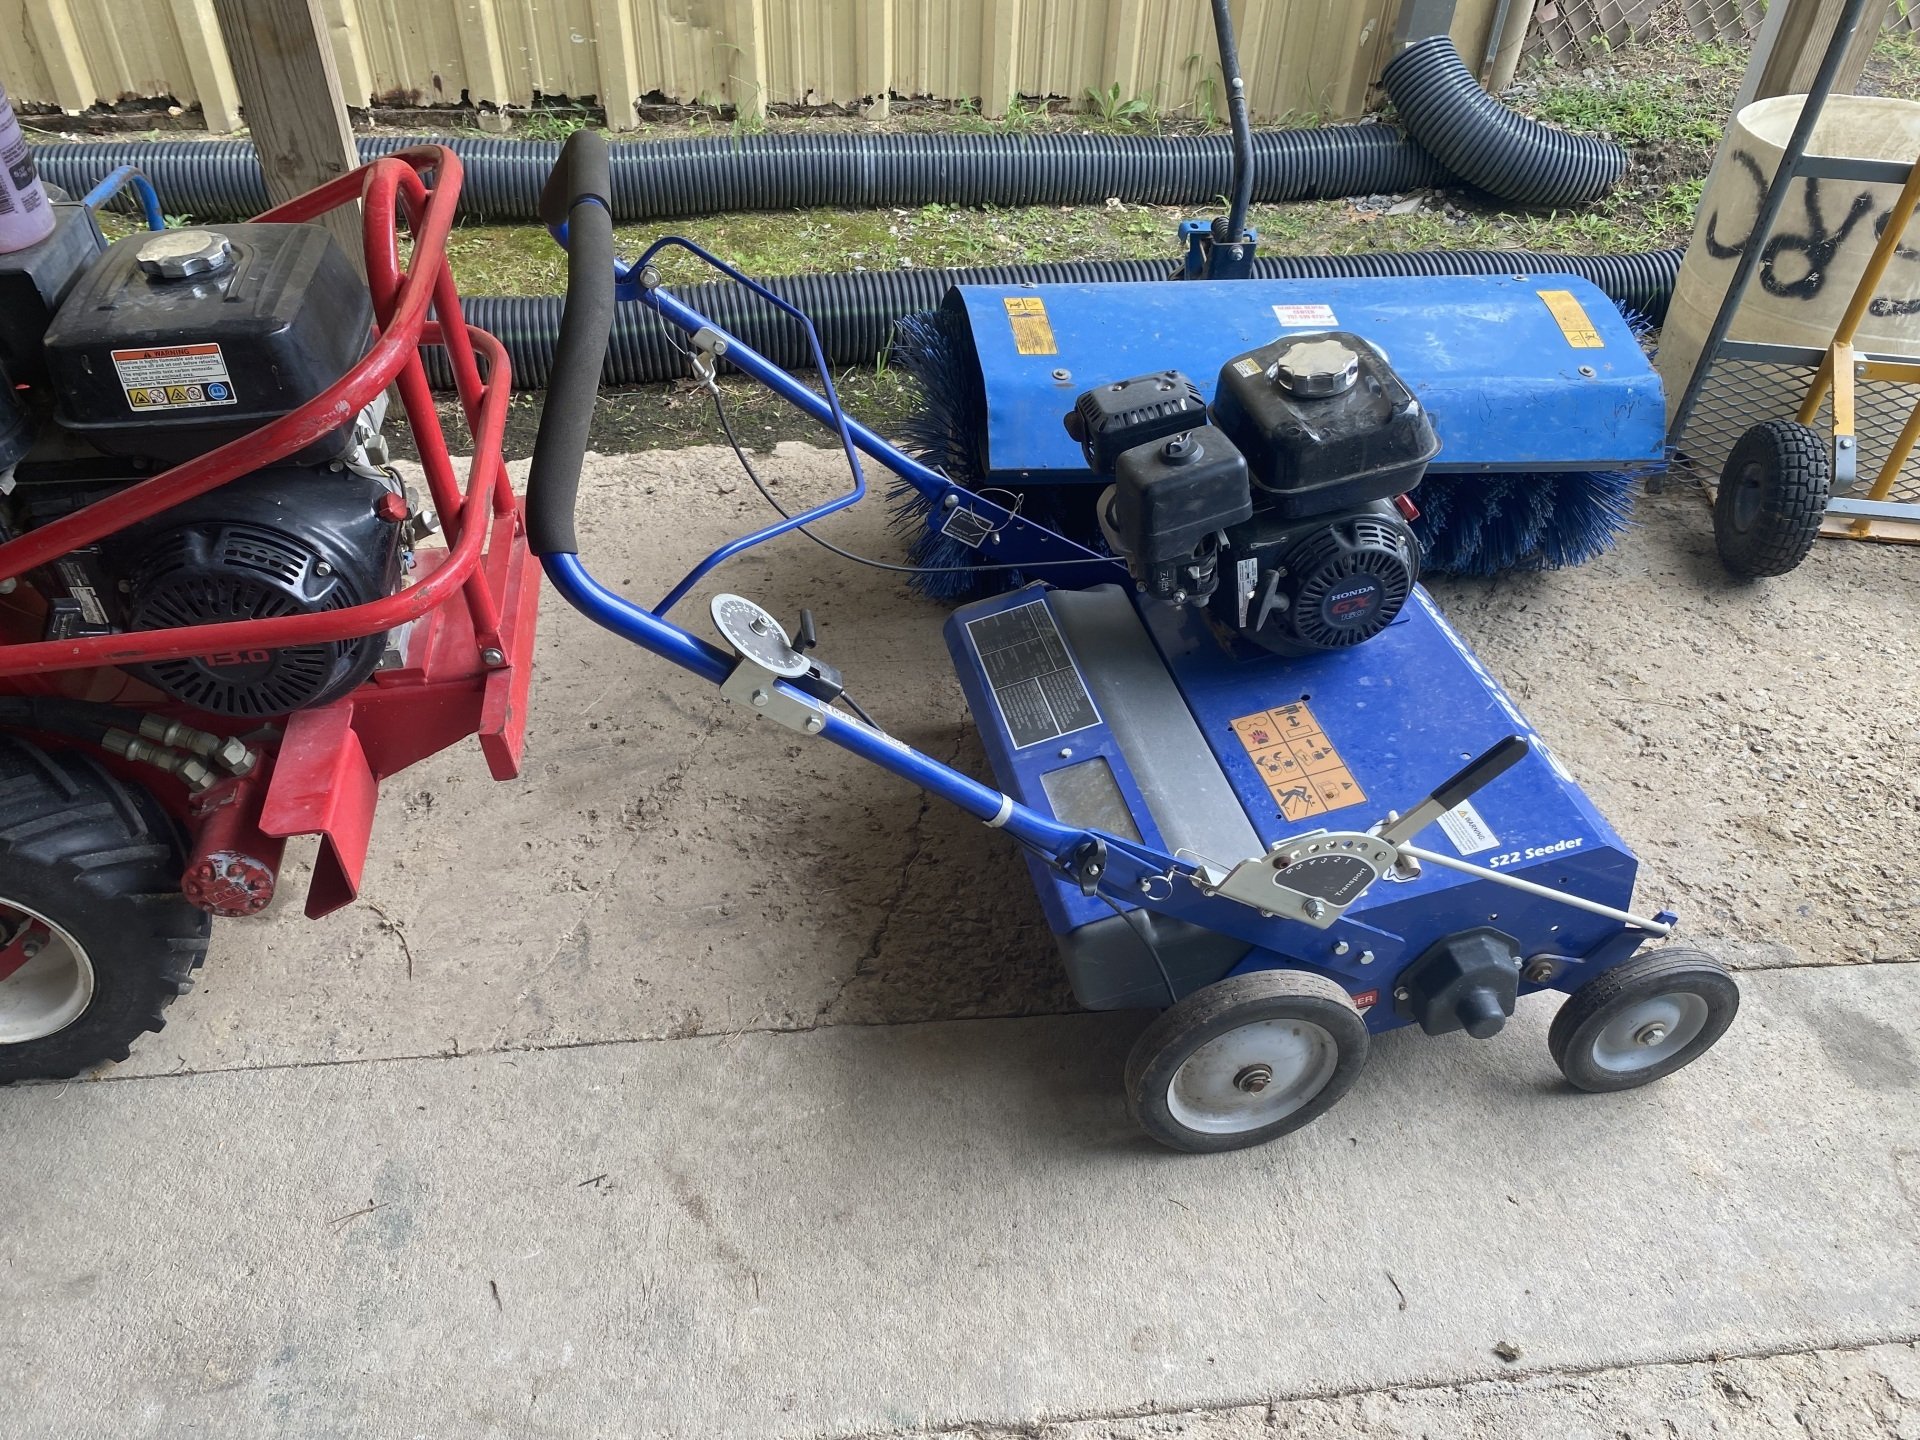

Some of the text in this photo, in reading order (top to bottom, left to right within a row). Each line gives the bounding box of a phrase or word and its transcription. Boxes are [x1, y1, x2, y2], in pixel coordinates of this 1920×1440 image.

[153, 349, 190, 357] WARNING
[1331, 586, 1376, 601] HONDA
[1465, 816, 1486, 841] WARNING
[1489, 837, 1584, 869] S22 Seeder
[1334, 867, 1367, 896] Transport
